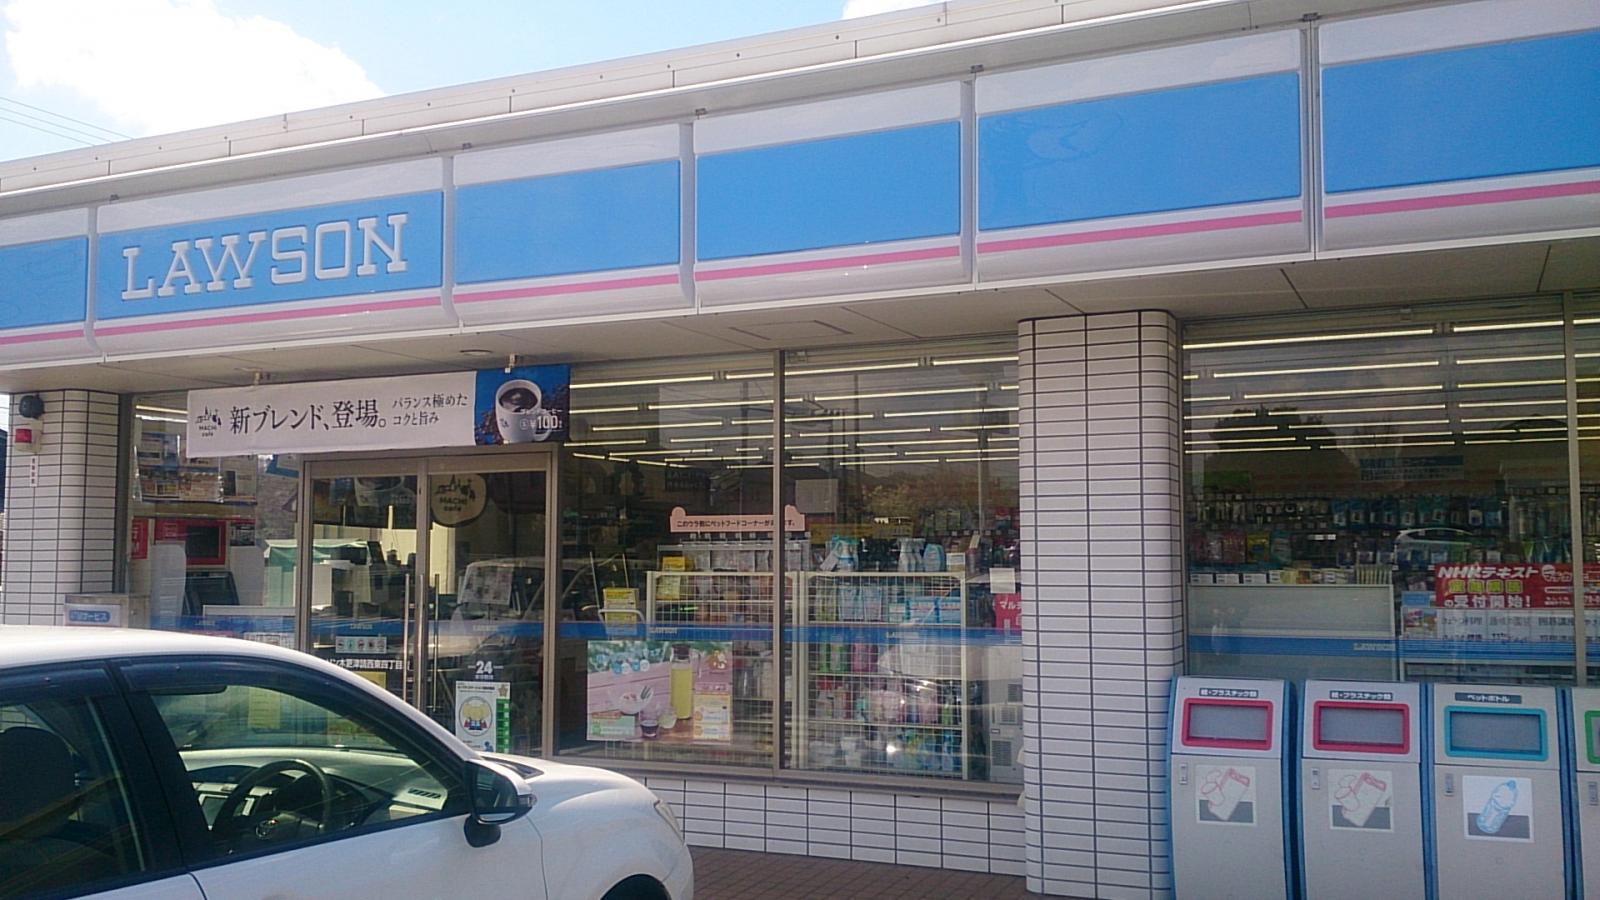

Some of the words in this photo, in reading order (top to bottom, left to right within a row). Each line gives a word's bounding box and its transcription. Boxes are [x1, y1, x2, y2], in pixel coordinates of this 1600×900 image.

[121, 212, 409, 301] LAWSON
[392, 393, 468, 409] バランス極めた
[230, 399, 387, 435] 新ブレンド、登場。
[392, 412, 440, 426] コクと旨み
[1438, 566, 1539, 579] NHKテキスト
[475, 660, 493, 674] 24
